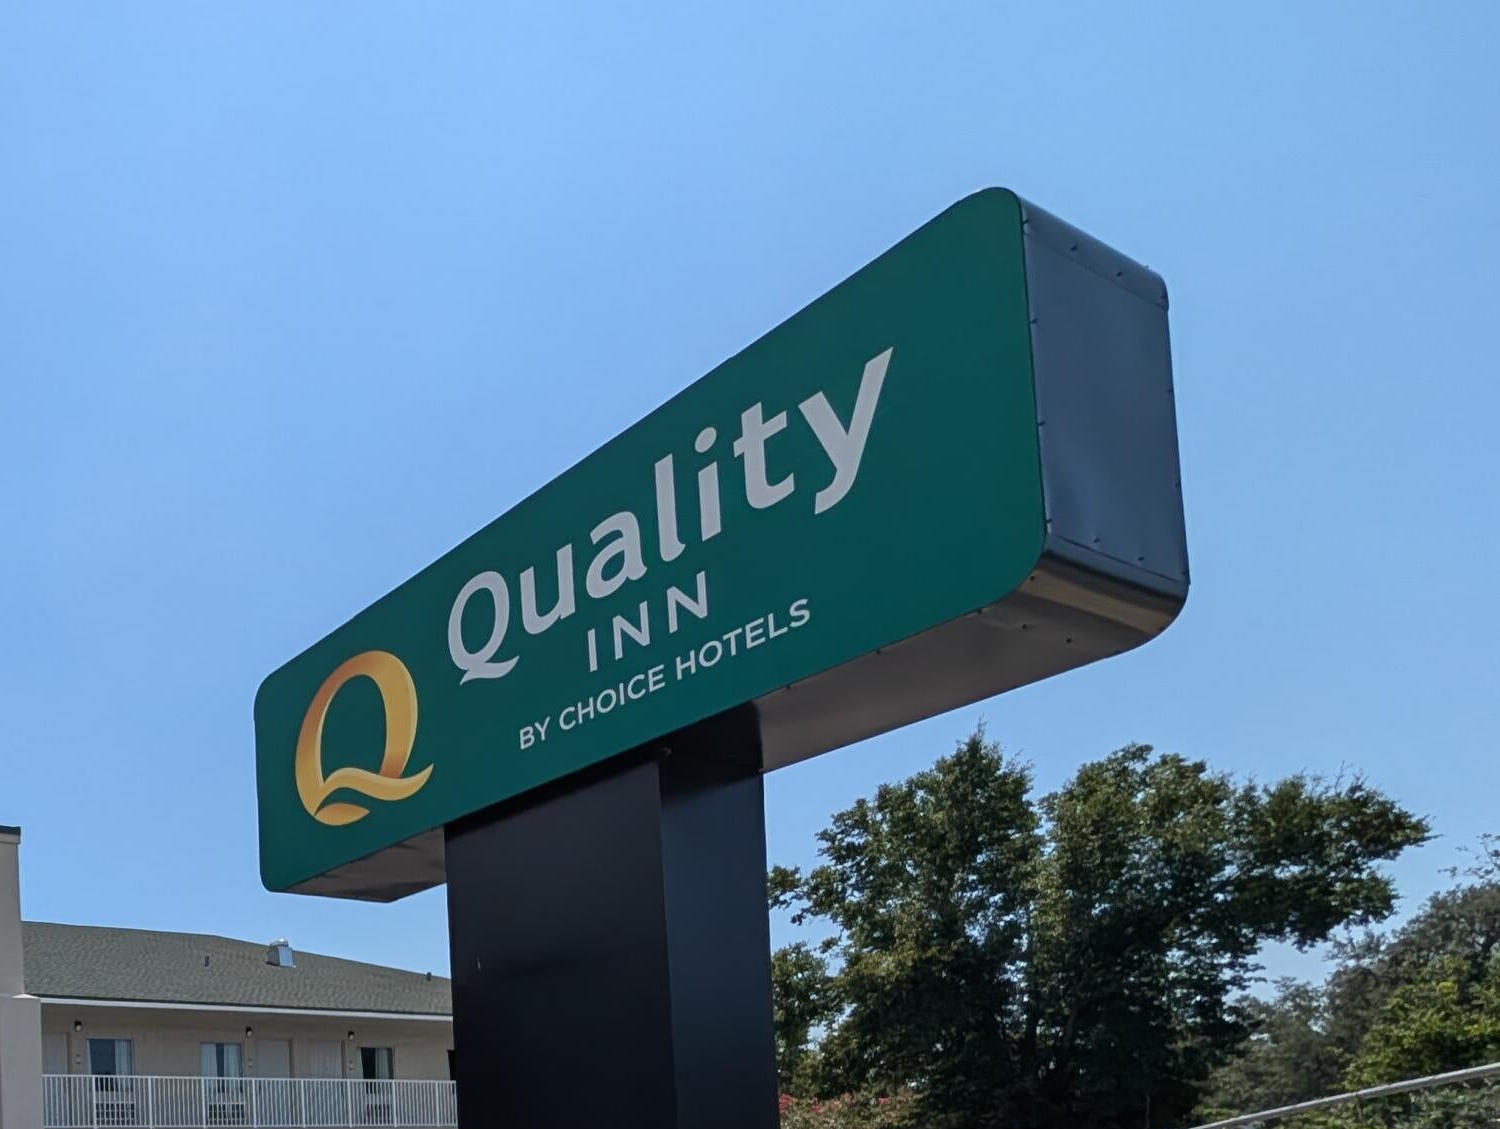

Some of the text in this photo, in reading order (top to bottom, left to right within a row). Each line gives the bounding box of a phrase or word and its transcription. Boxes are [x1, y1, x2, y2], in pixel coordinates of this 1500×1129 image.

[447, 346, 894, 686] Quality
[519, 598, 811, 750] BY CHOICE HOTELS
[587, 571, 708, 672] INN
